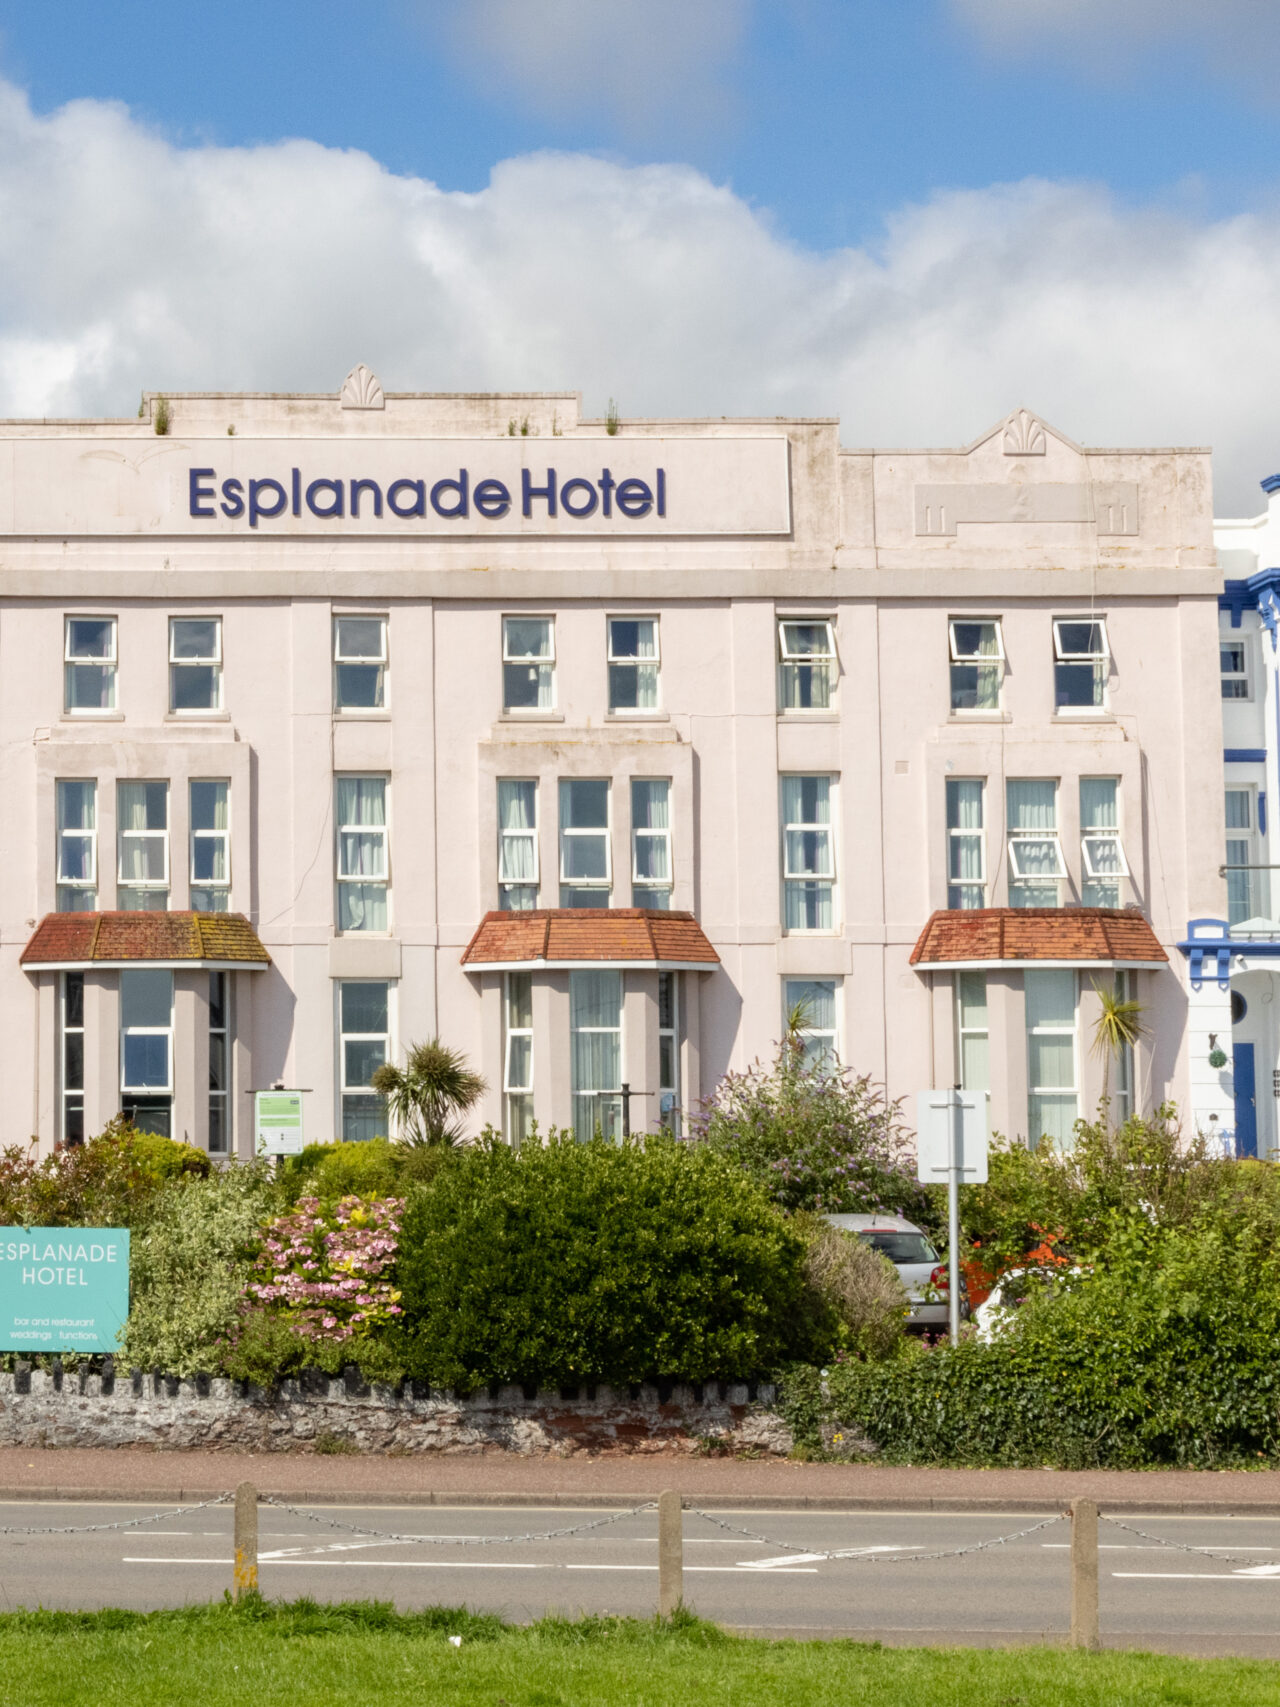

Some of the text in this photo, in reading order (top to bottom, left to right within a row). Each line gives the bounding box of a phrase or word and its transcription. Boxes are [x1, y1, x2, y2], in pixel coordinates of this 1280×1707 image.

[189, 468, 667, 527] Esplanade Hotel
[22, 1266, 89, 1286] HOTEL
[14, 1317, 95, 1327] bar and restaurant
[10, 1330, 98, 1341] weddings functions
